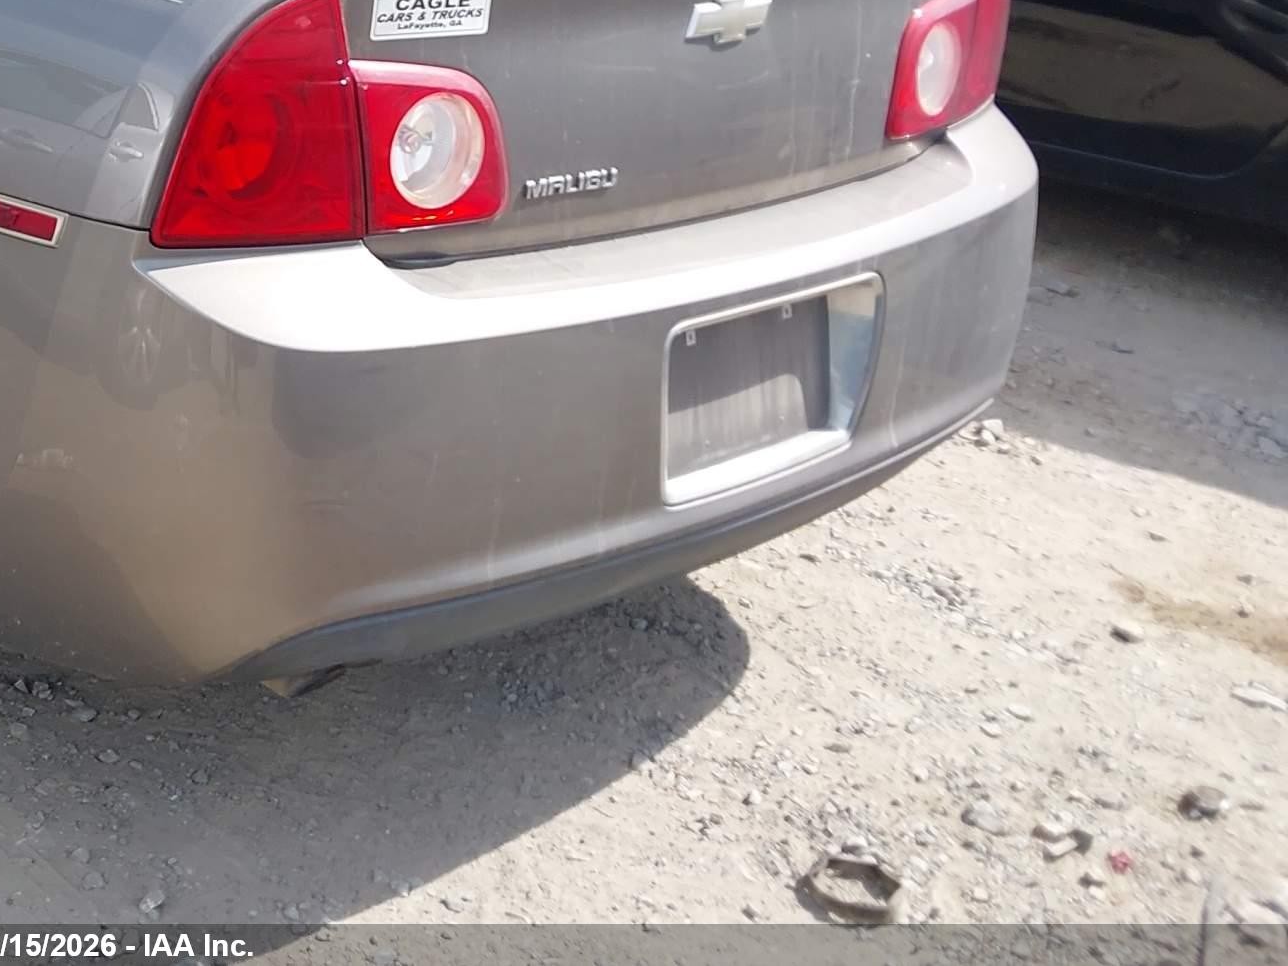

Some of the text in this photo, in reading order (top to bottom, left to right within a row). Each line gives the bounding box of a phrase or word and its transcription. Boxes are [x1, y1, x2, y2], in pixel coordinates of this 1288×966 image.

[376, 8, 483, 23] CARS & TRUCKS
[524, 166, 618, 200] MALIBU
